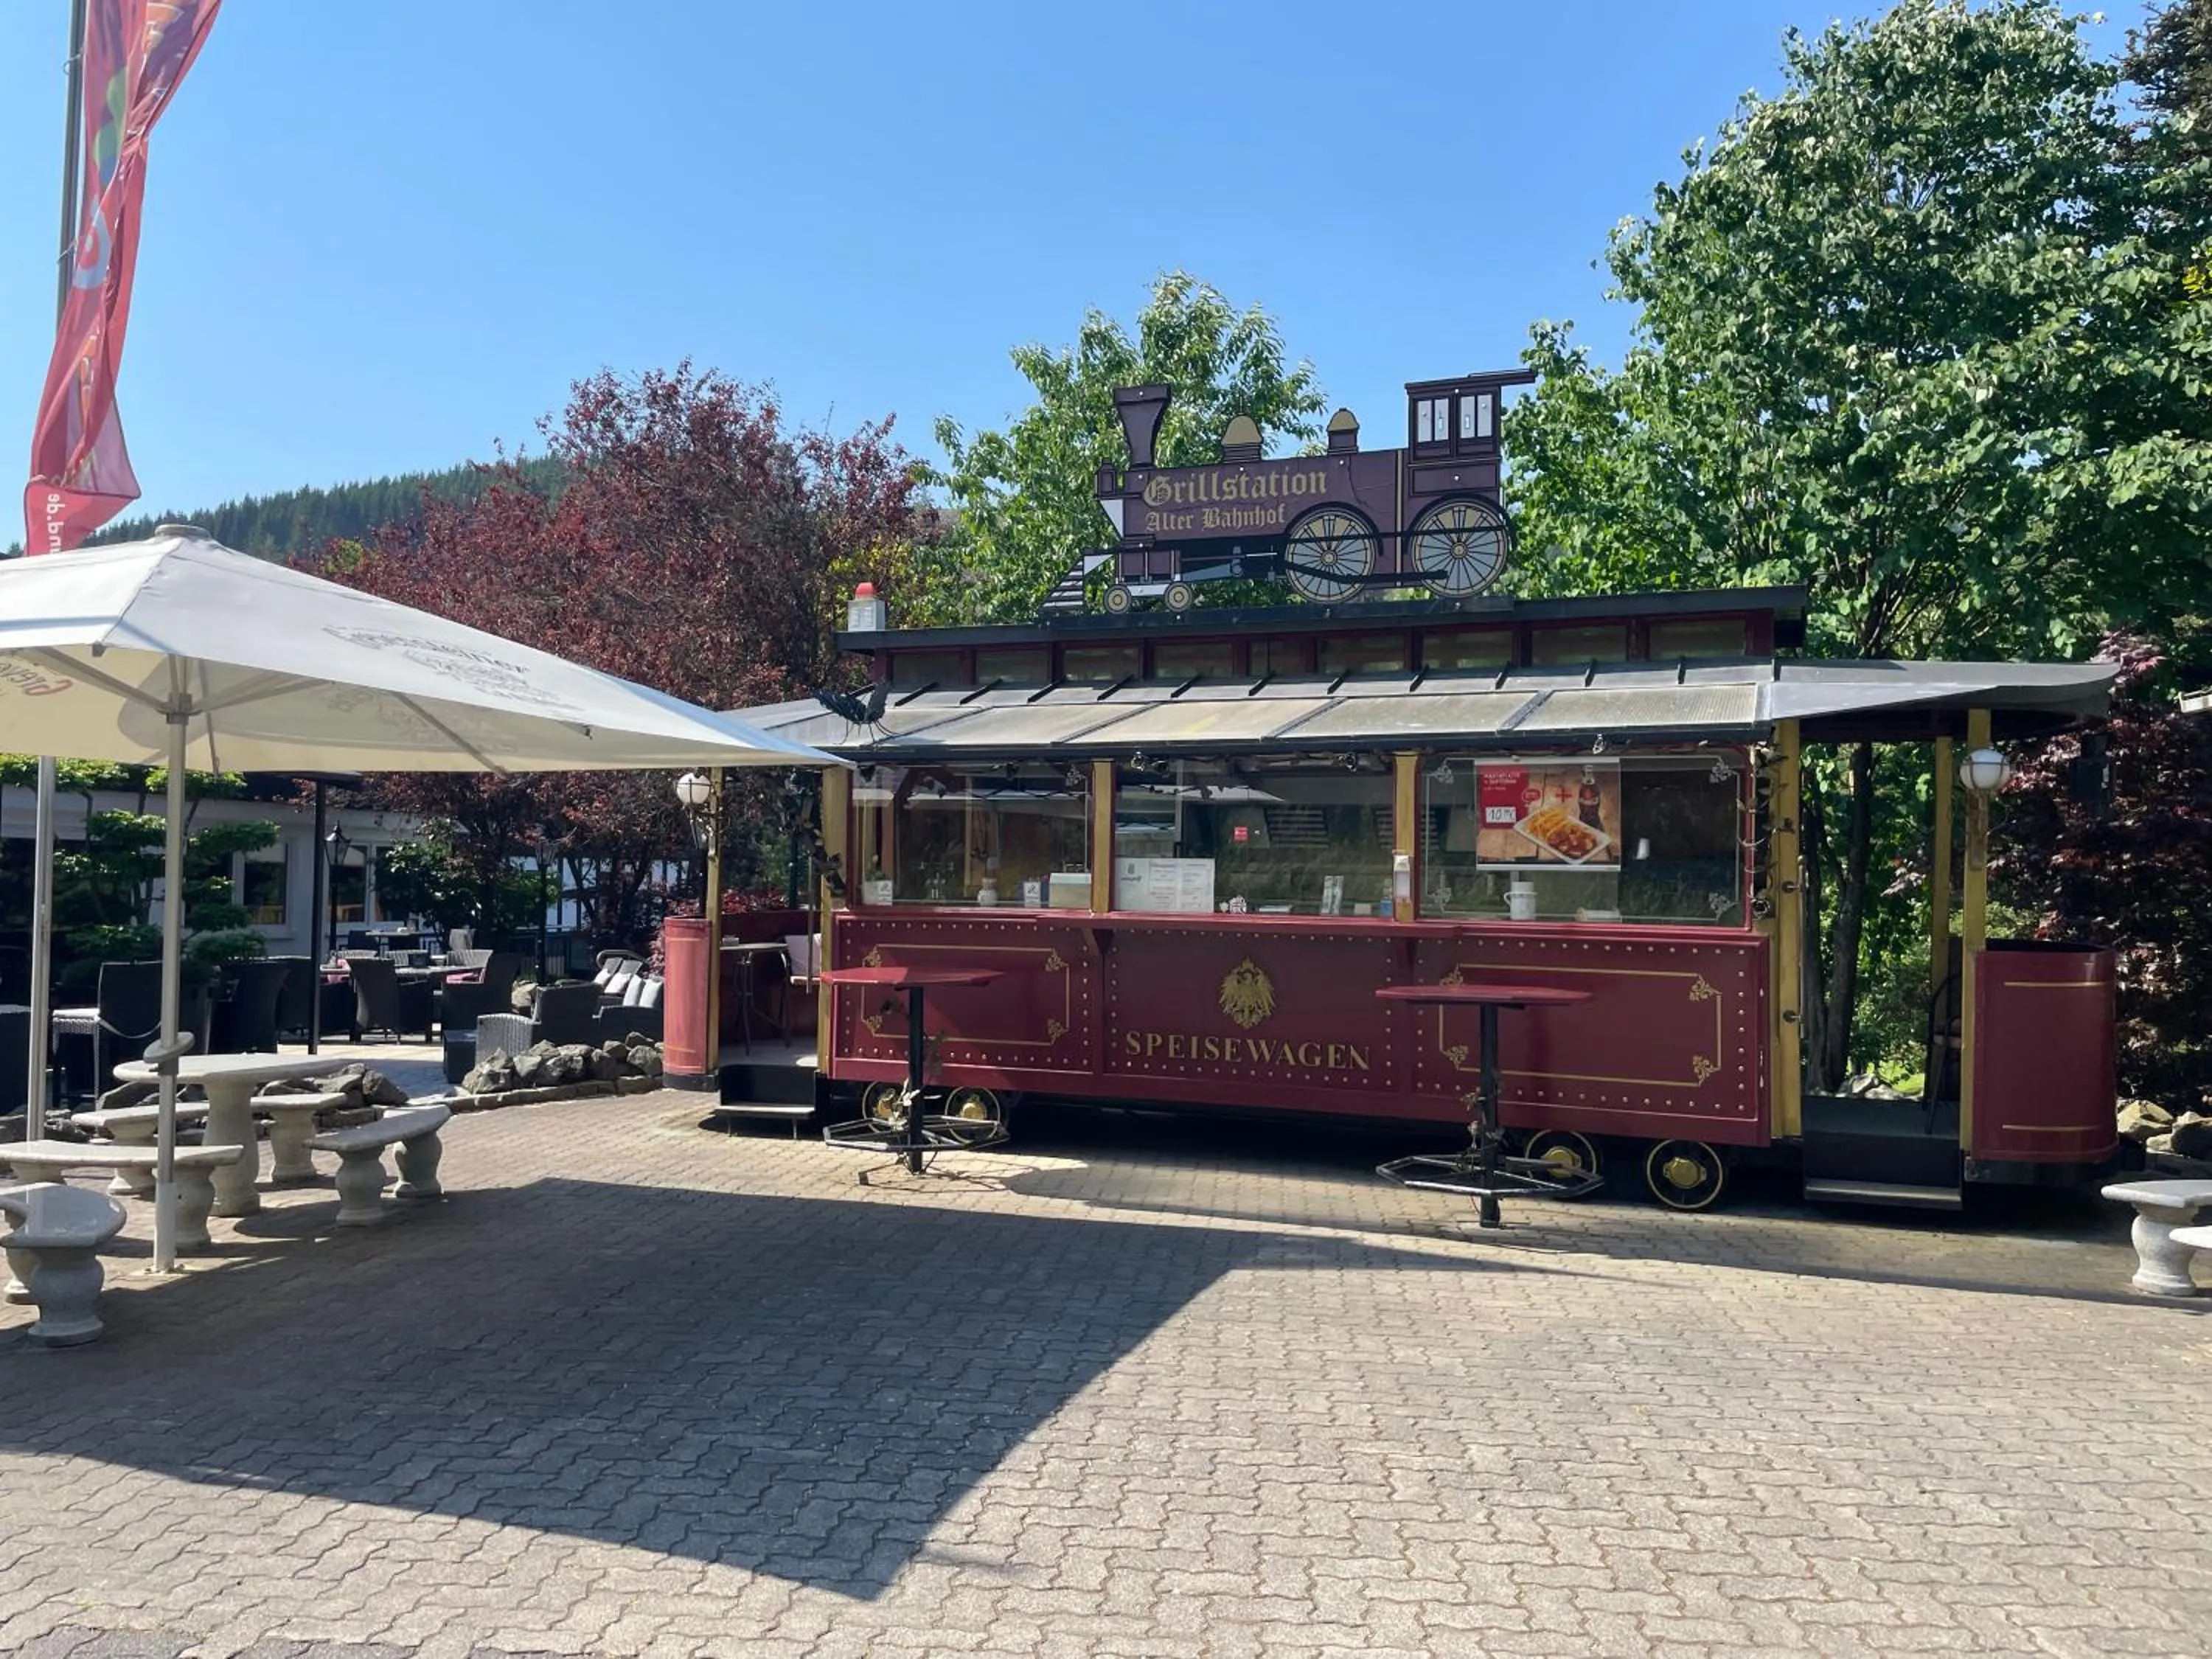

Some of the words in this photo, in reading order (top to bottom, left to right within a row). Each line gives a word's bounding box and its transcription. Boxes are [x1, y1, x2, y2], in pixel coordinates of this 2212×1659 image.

[1144, 466, 1327, 507] Grillstation
[1145, 511, 1194, 532] Alter
[1201, 504, 1285, 531] Bahnhof
[1126, 1030, 1369, 1070] SPEISEWAGEN
